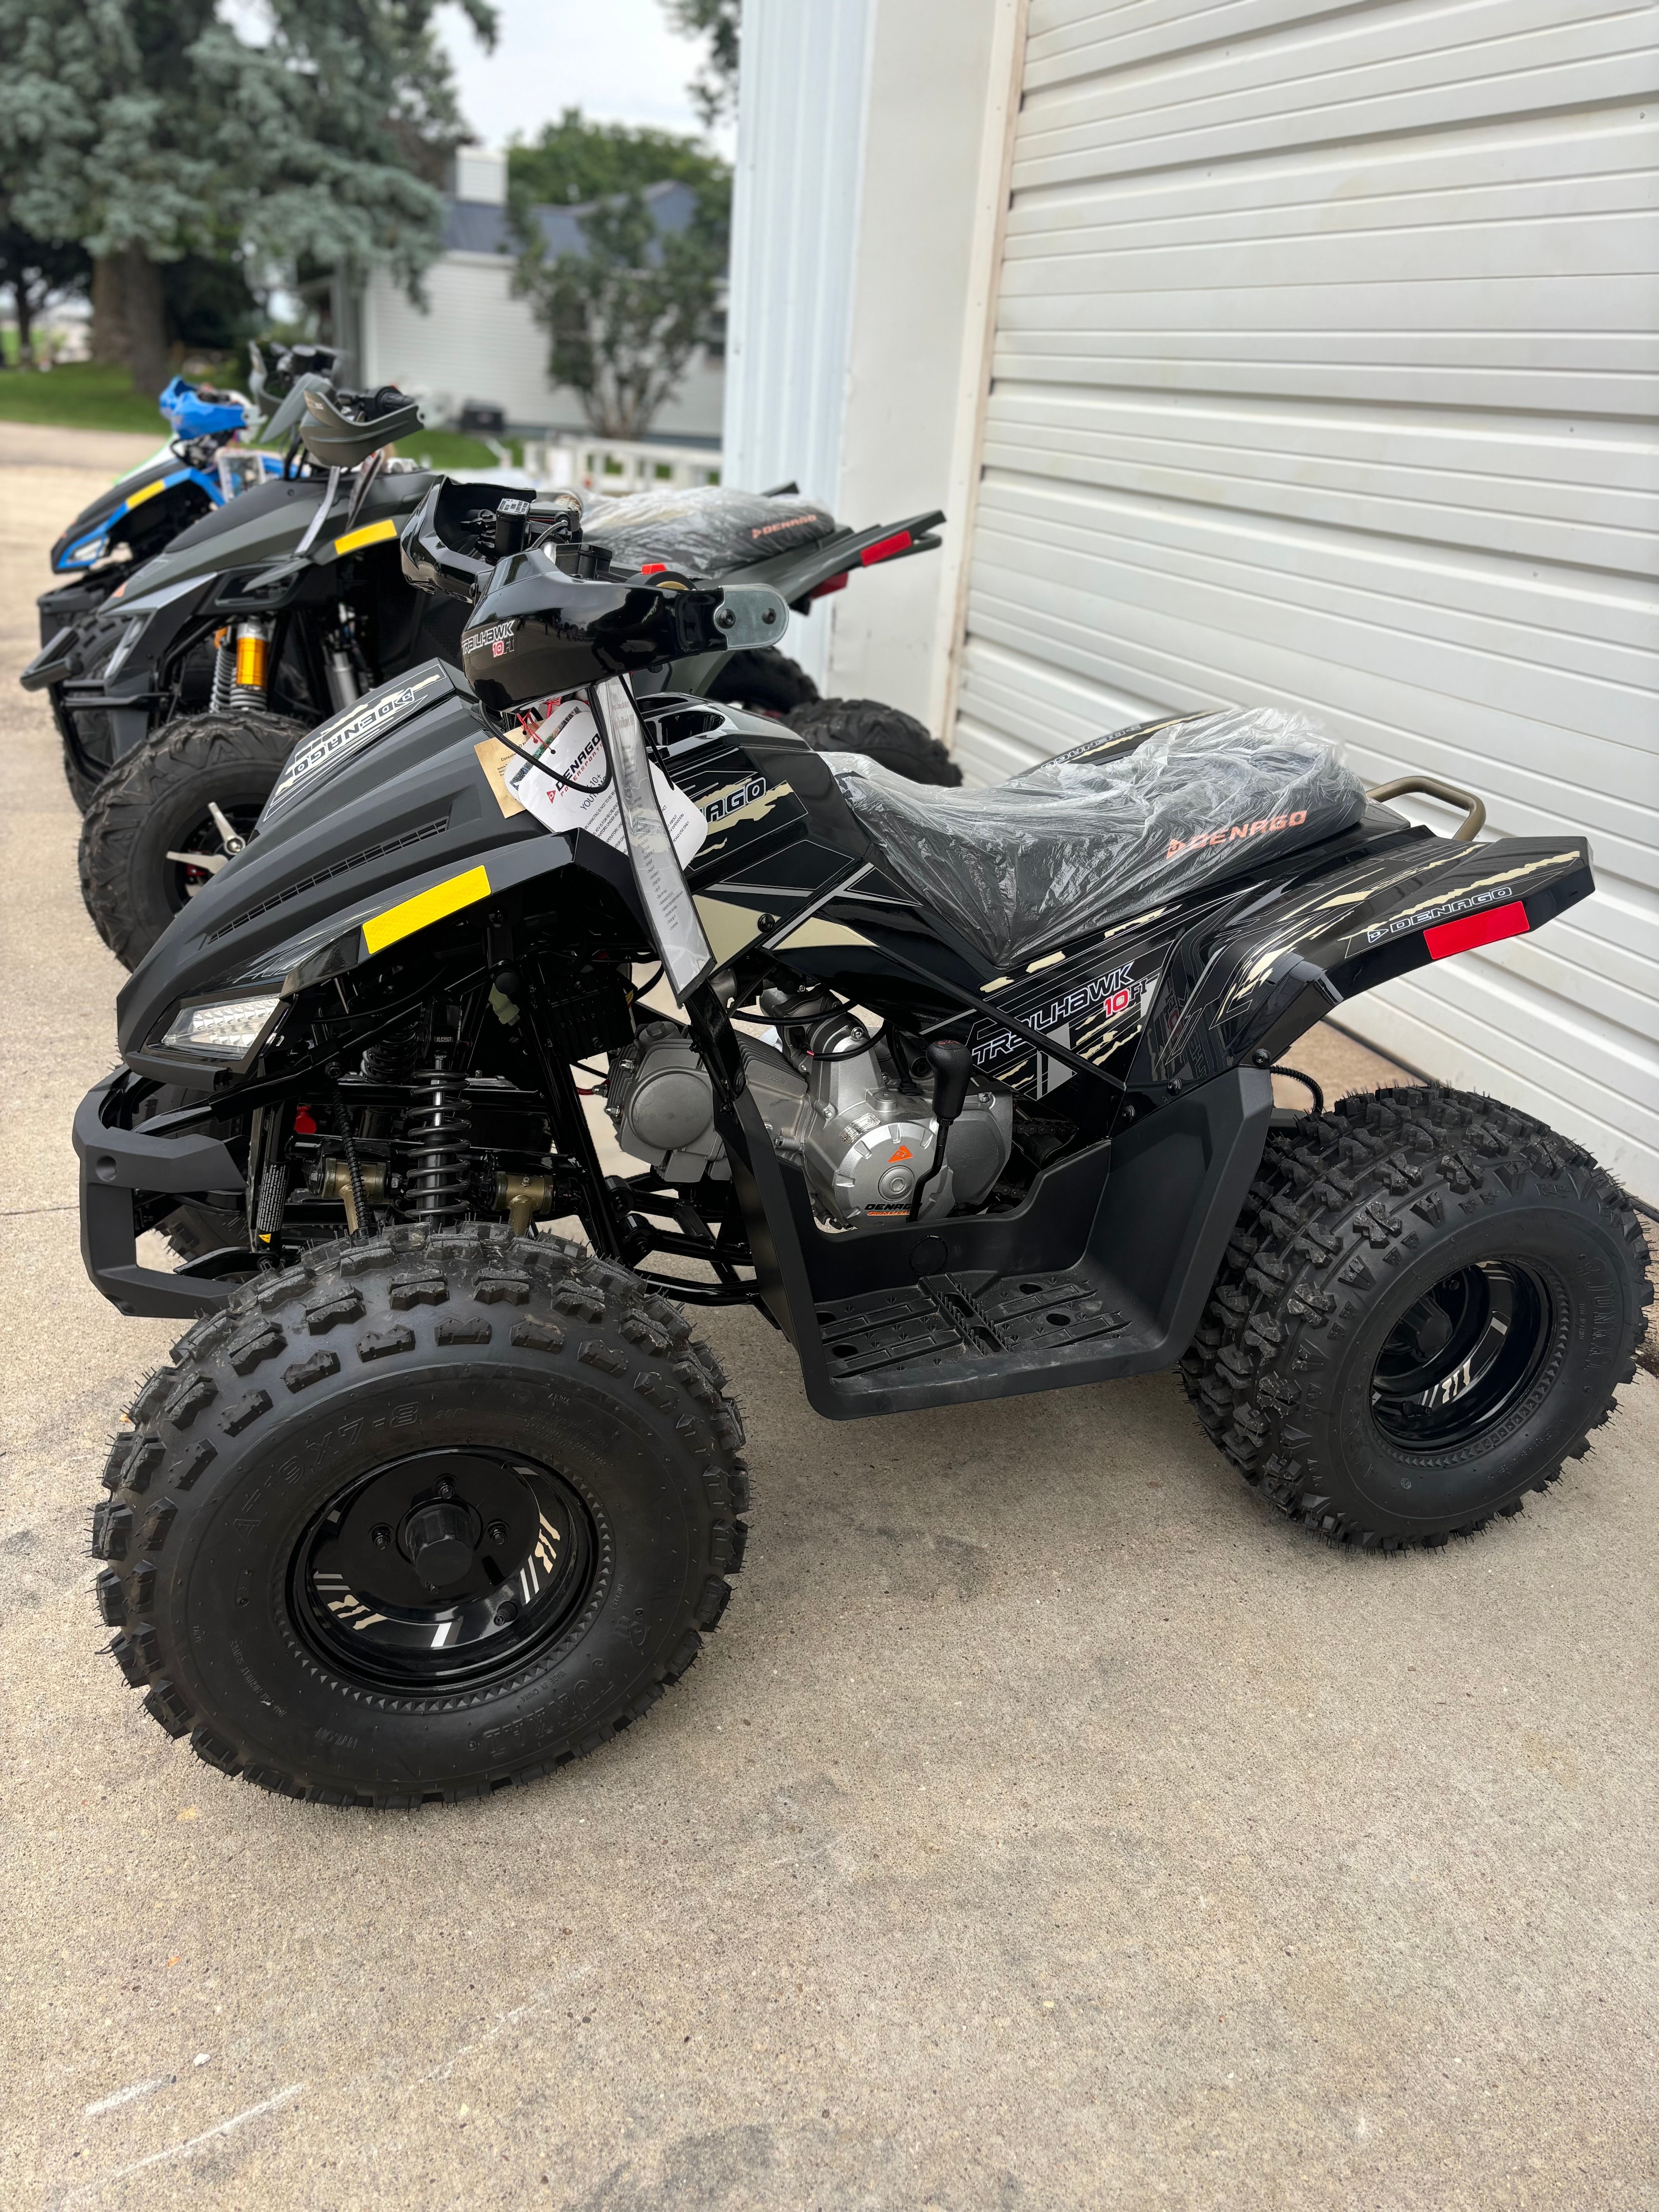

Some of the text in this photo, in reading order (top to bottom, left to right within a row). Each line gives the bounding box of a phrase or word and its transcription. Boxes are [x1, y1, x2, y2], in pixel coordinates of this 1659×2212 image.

[293, 701, 394, 777] DENAGO
[580, 793, 599, 810] YOUT
[698, 777, 766, 824] AGO
[1190, 810, 1307, 850] DENAGO
[1390, 887, 1512, 933] DENAGO
